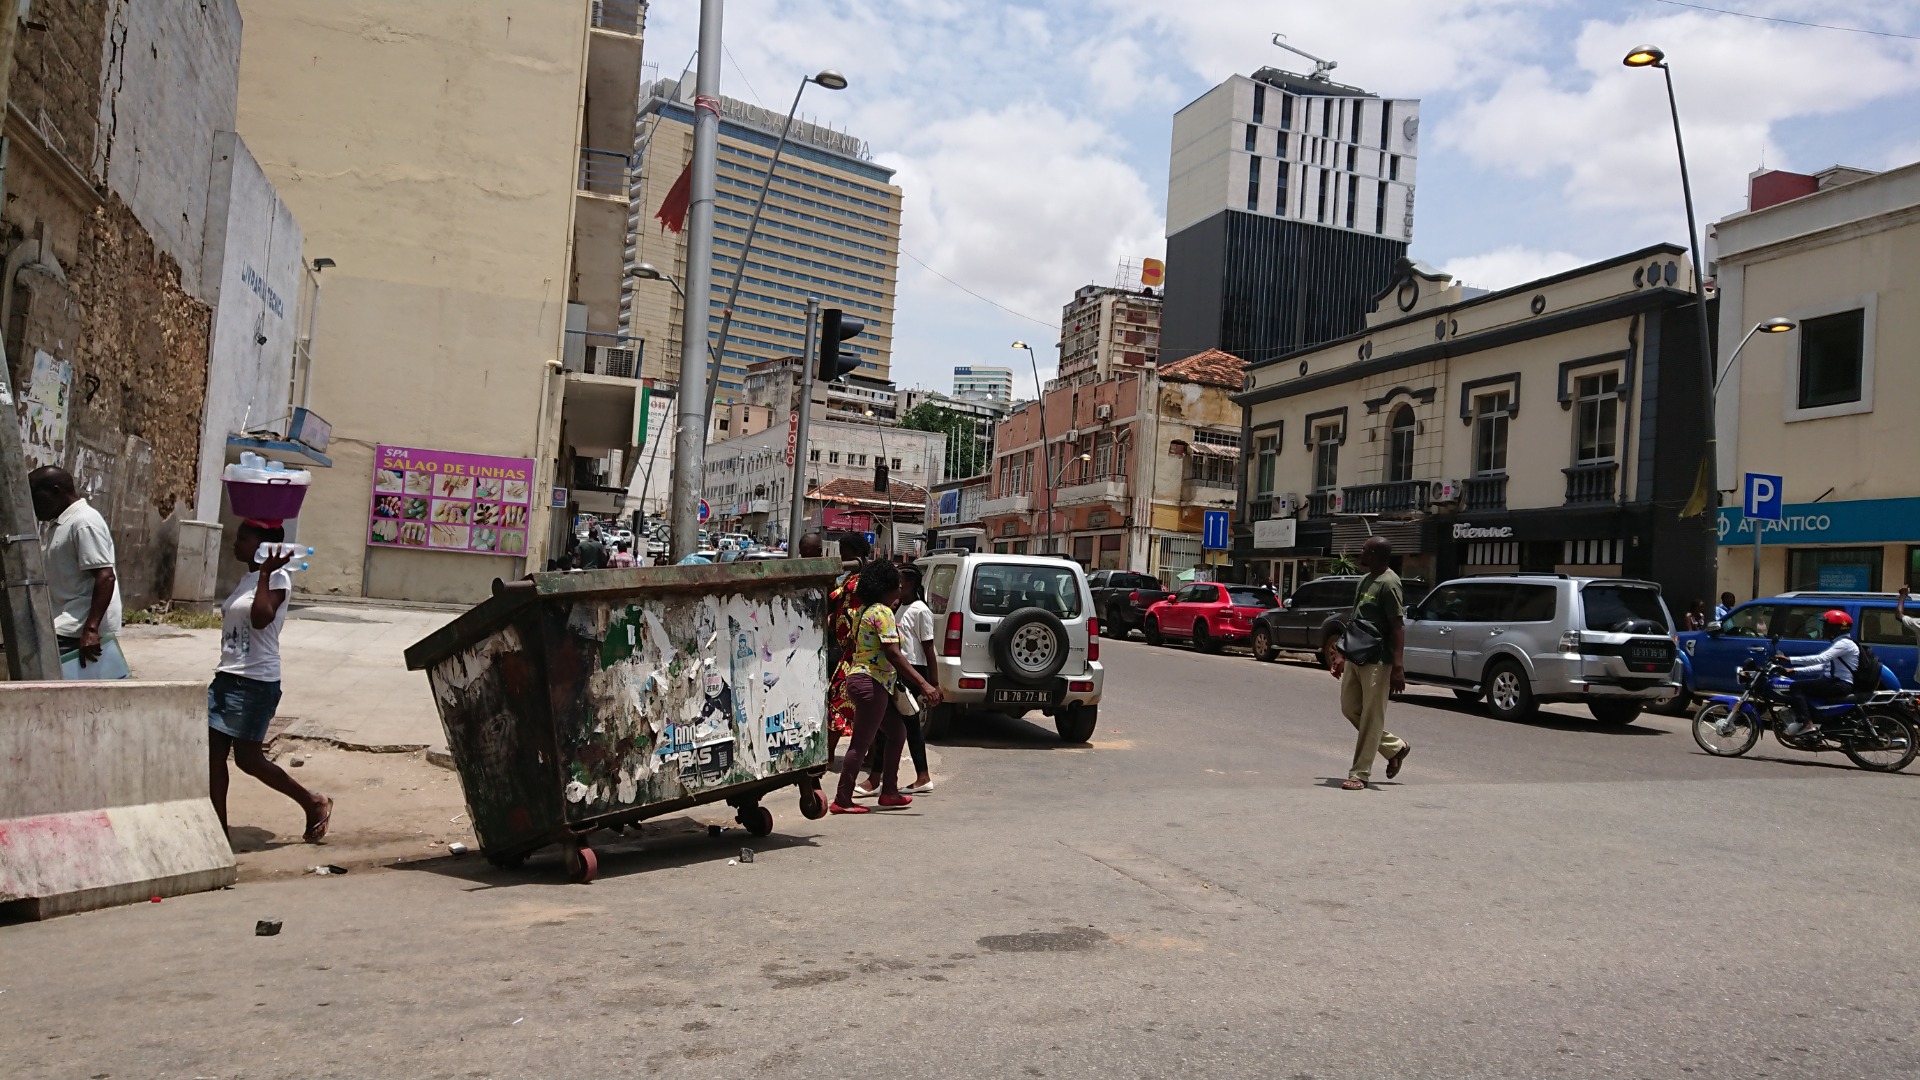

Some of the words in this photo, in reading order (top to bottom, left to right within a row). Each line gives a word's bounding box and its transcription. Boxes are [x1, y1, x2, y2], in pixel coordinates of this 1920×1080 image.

[721, 99, 755, 121] EPIC
[813, 115, 870, 162] LUANDA
[384, 448, 408, 458] SPA
[786, 413, 798, 465] GLOBO
[383, 458, 437, 472] SALAO
[443, 463, 465, 474] DE
[469, 466, 526, 480] UNHAS
[1751, 477, 1775, 514] P
[706, 684, 720, 693] ZERO
